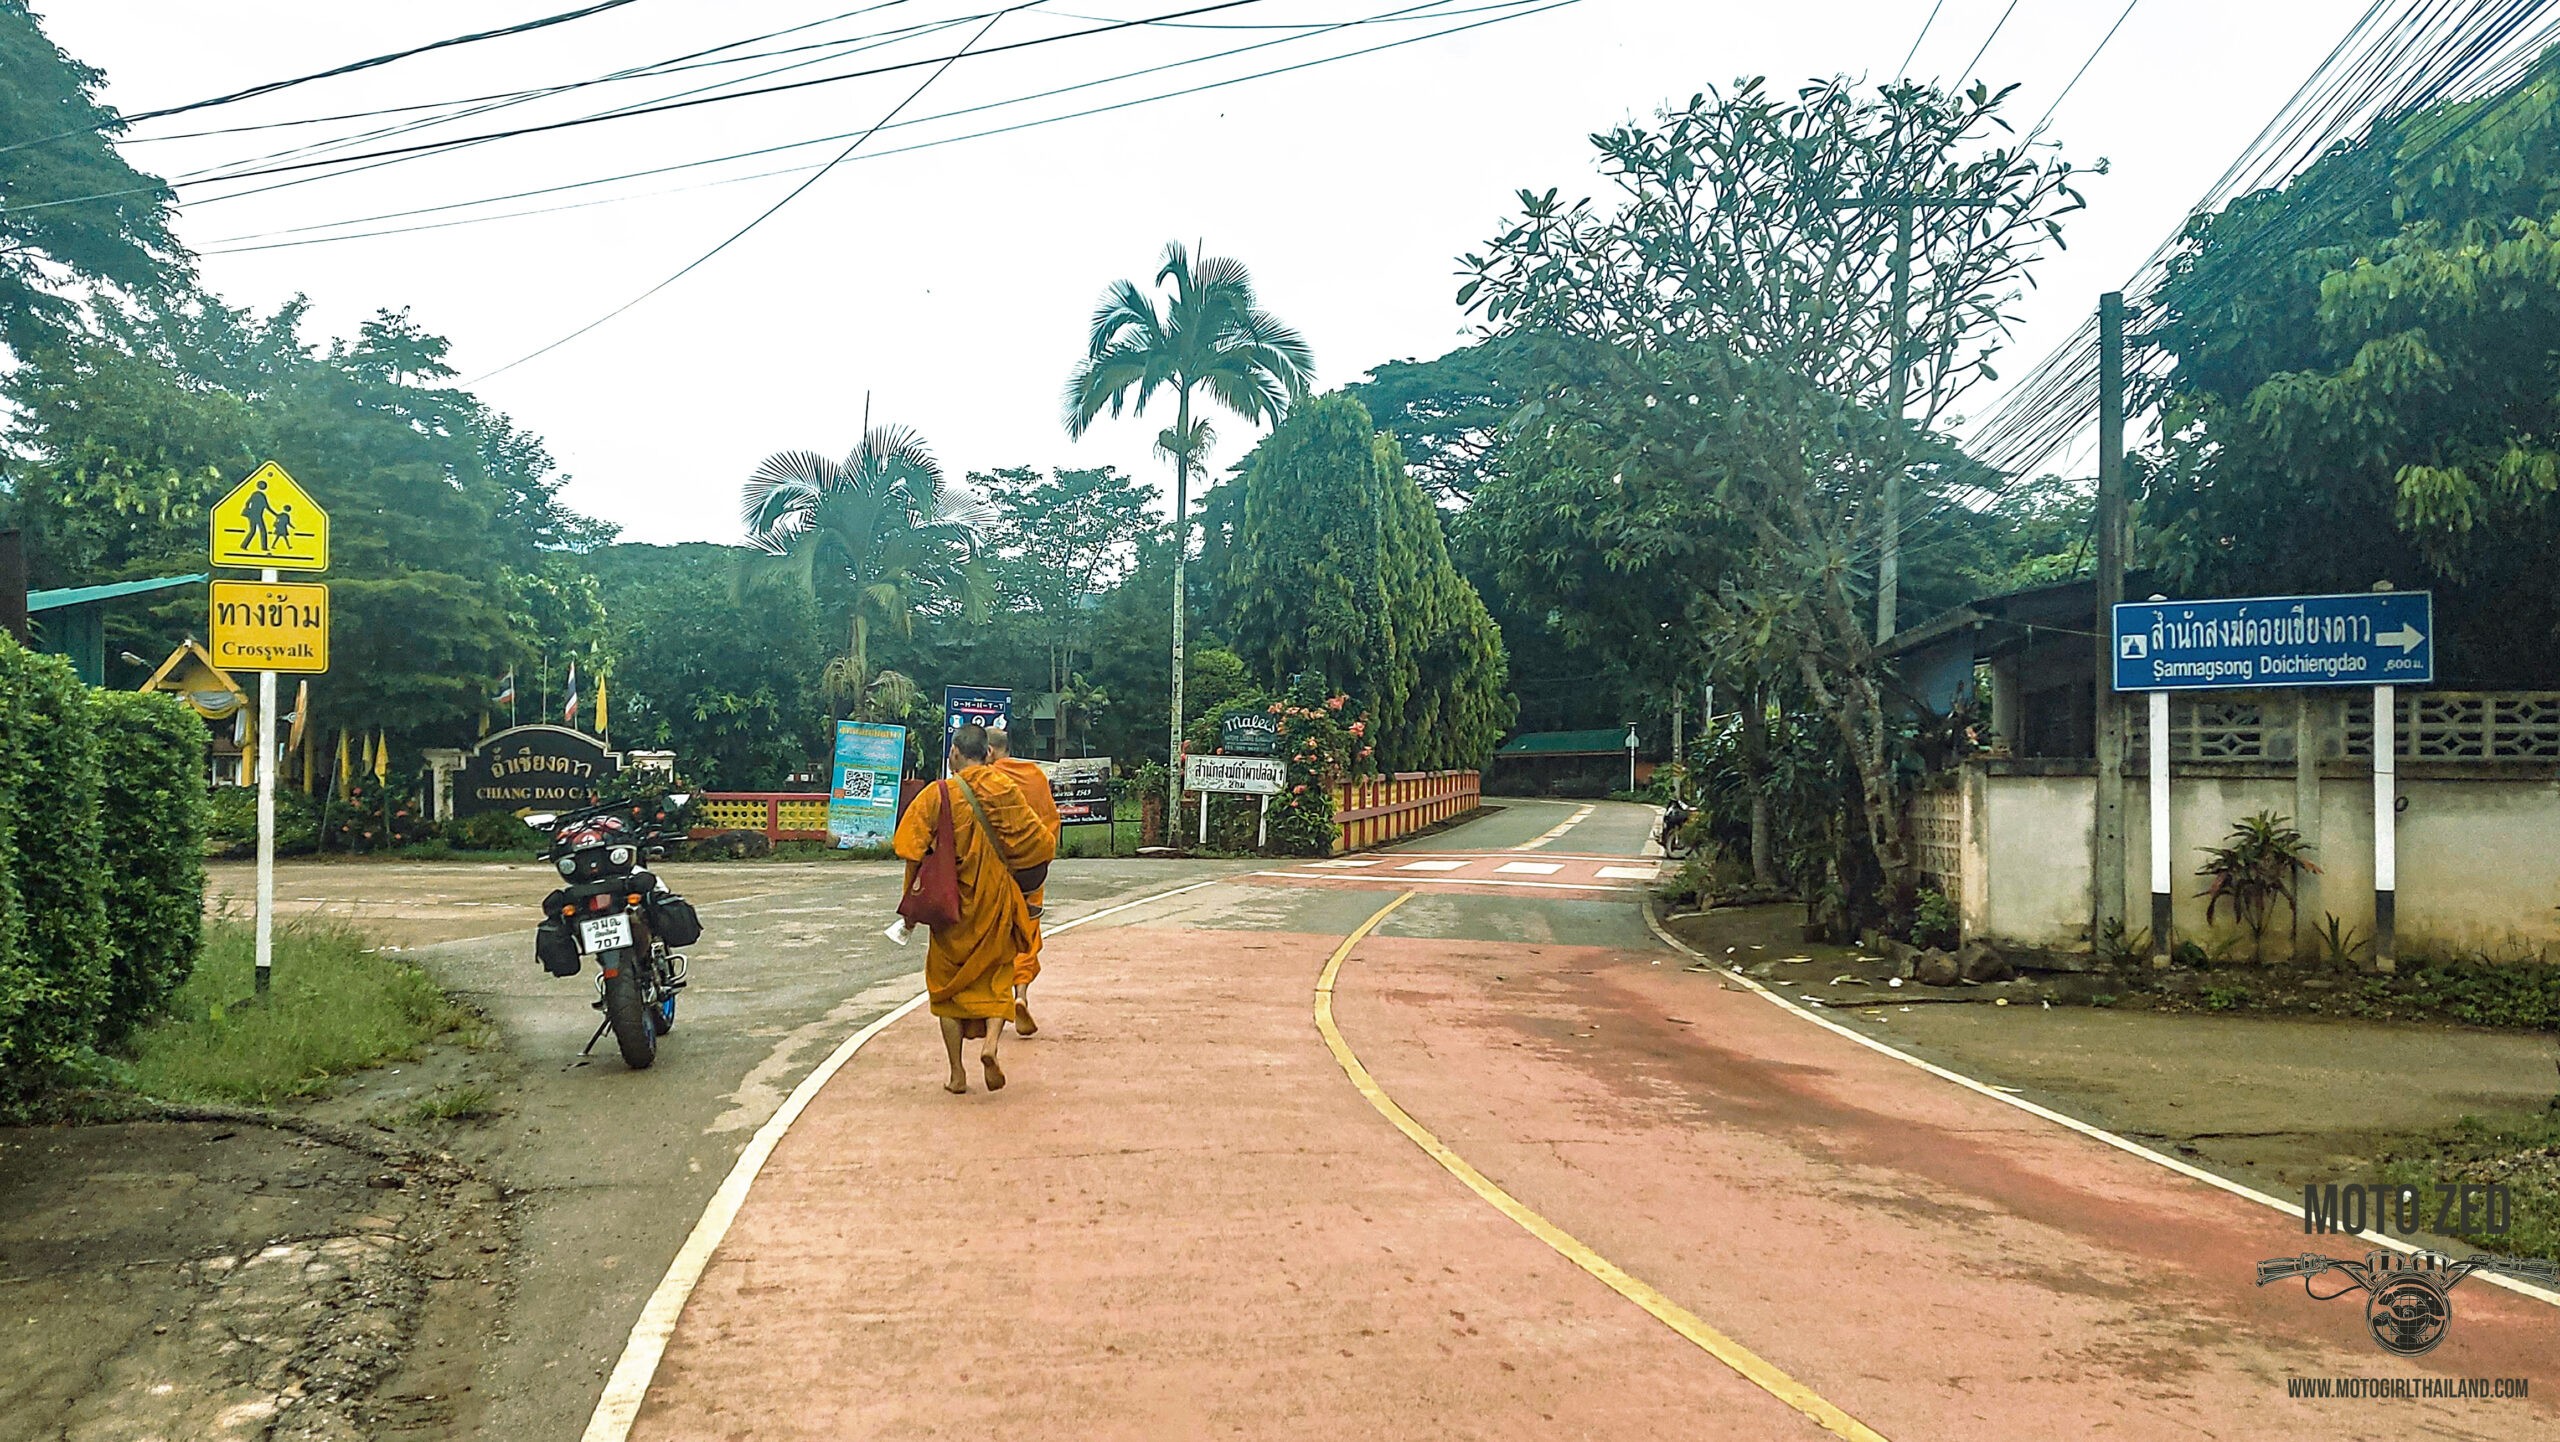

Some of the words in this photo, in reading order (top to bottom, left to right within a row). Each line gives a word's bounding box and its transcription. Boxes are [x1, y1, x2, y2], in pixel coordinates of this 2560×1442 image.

[217, 594, 321, 628] ทางข้าม
[2151, 604, 2371, 651] สำนักสงฆ์ดอยเชียงดาว
[221, 641, 314, 658] Crosswalk
[2152, 659, 2252, 681] Samnagsong
[2260, 653, 2367, 678] Doichiengdao
[491, 746, 592, 778] ถ้ำเชียงดาว
[476, 787, 532, 800] CHIANG
[535, 787, 565, 799] DAO
[594, 936, 620, 949] 707
